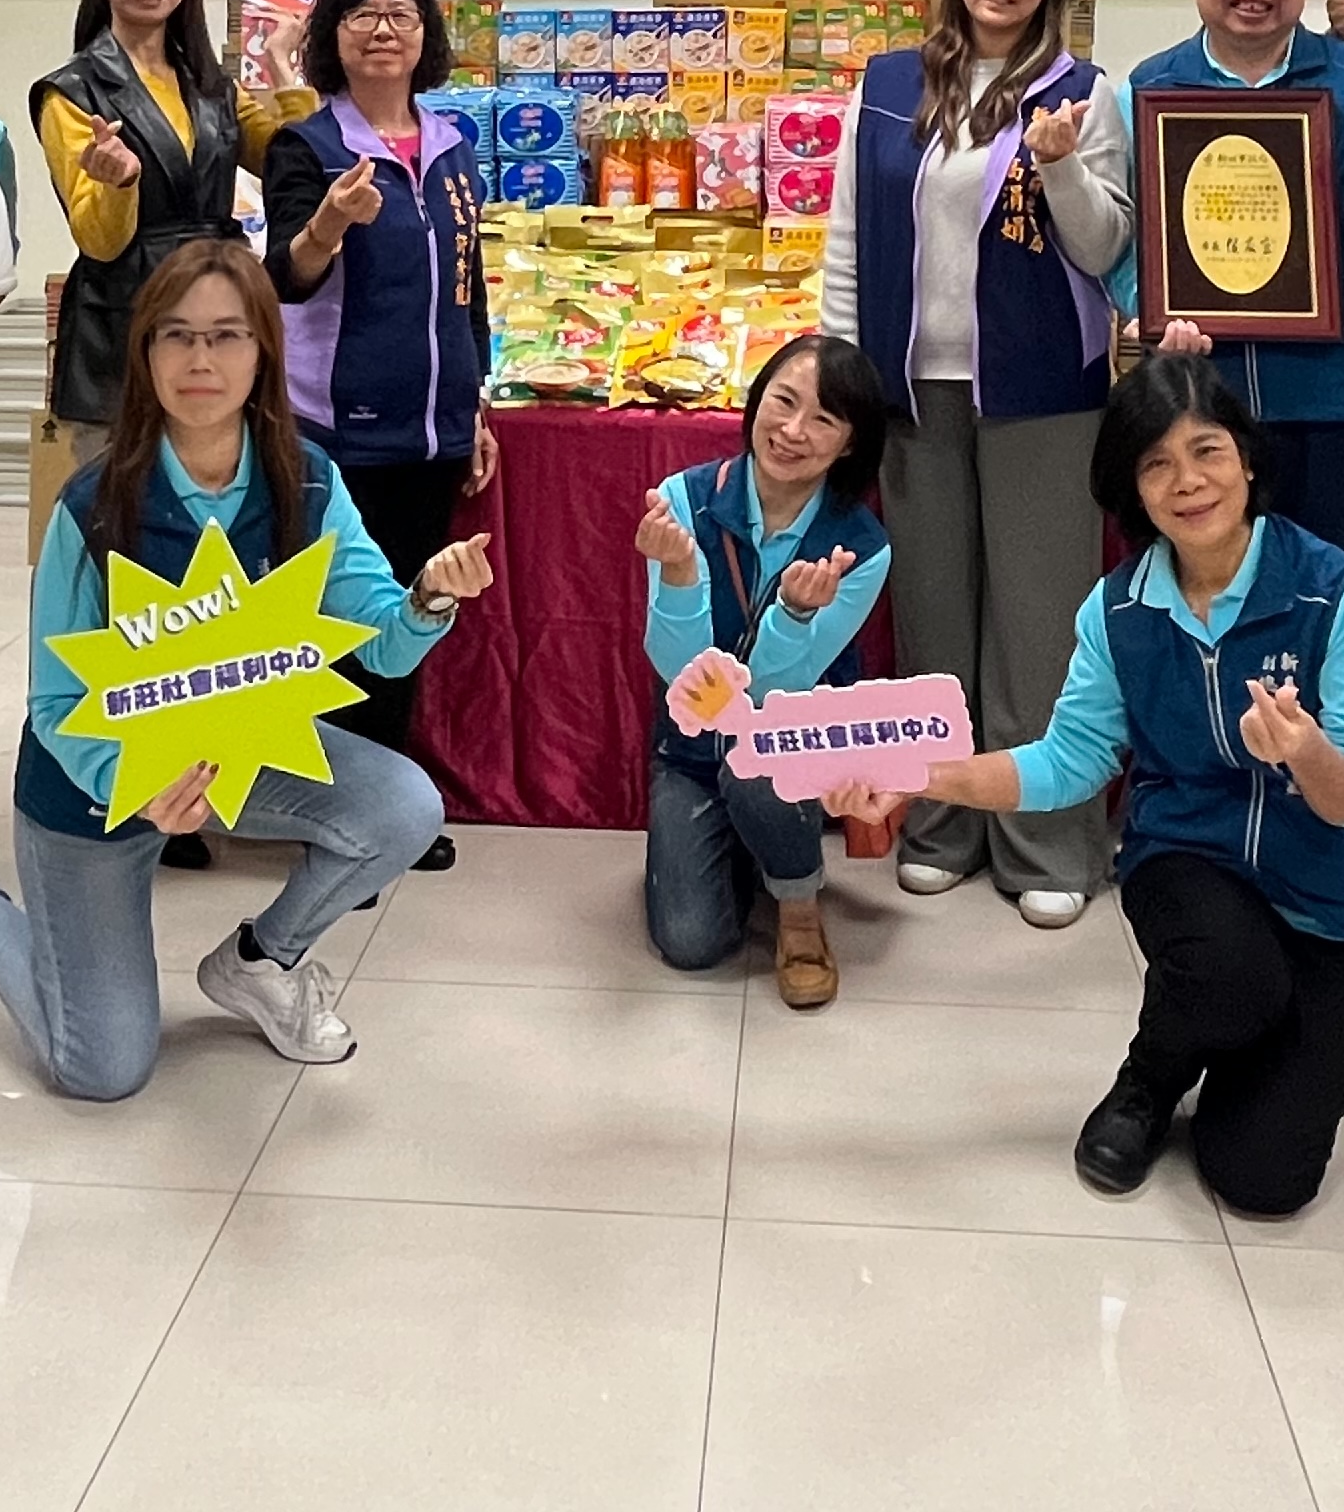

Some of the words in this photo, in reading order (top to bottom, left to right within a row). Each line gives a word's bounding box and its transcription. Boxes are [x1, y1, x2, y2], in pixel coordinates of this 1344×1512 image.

[114, 573, 240, 651] Wow!
[106, 645, 320, 716] 新莊社會福利中心
[752, 716, 950, 755] 新莊社會福利中心
